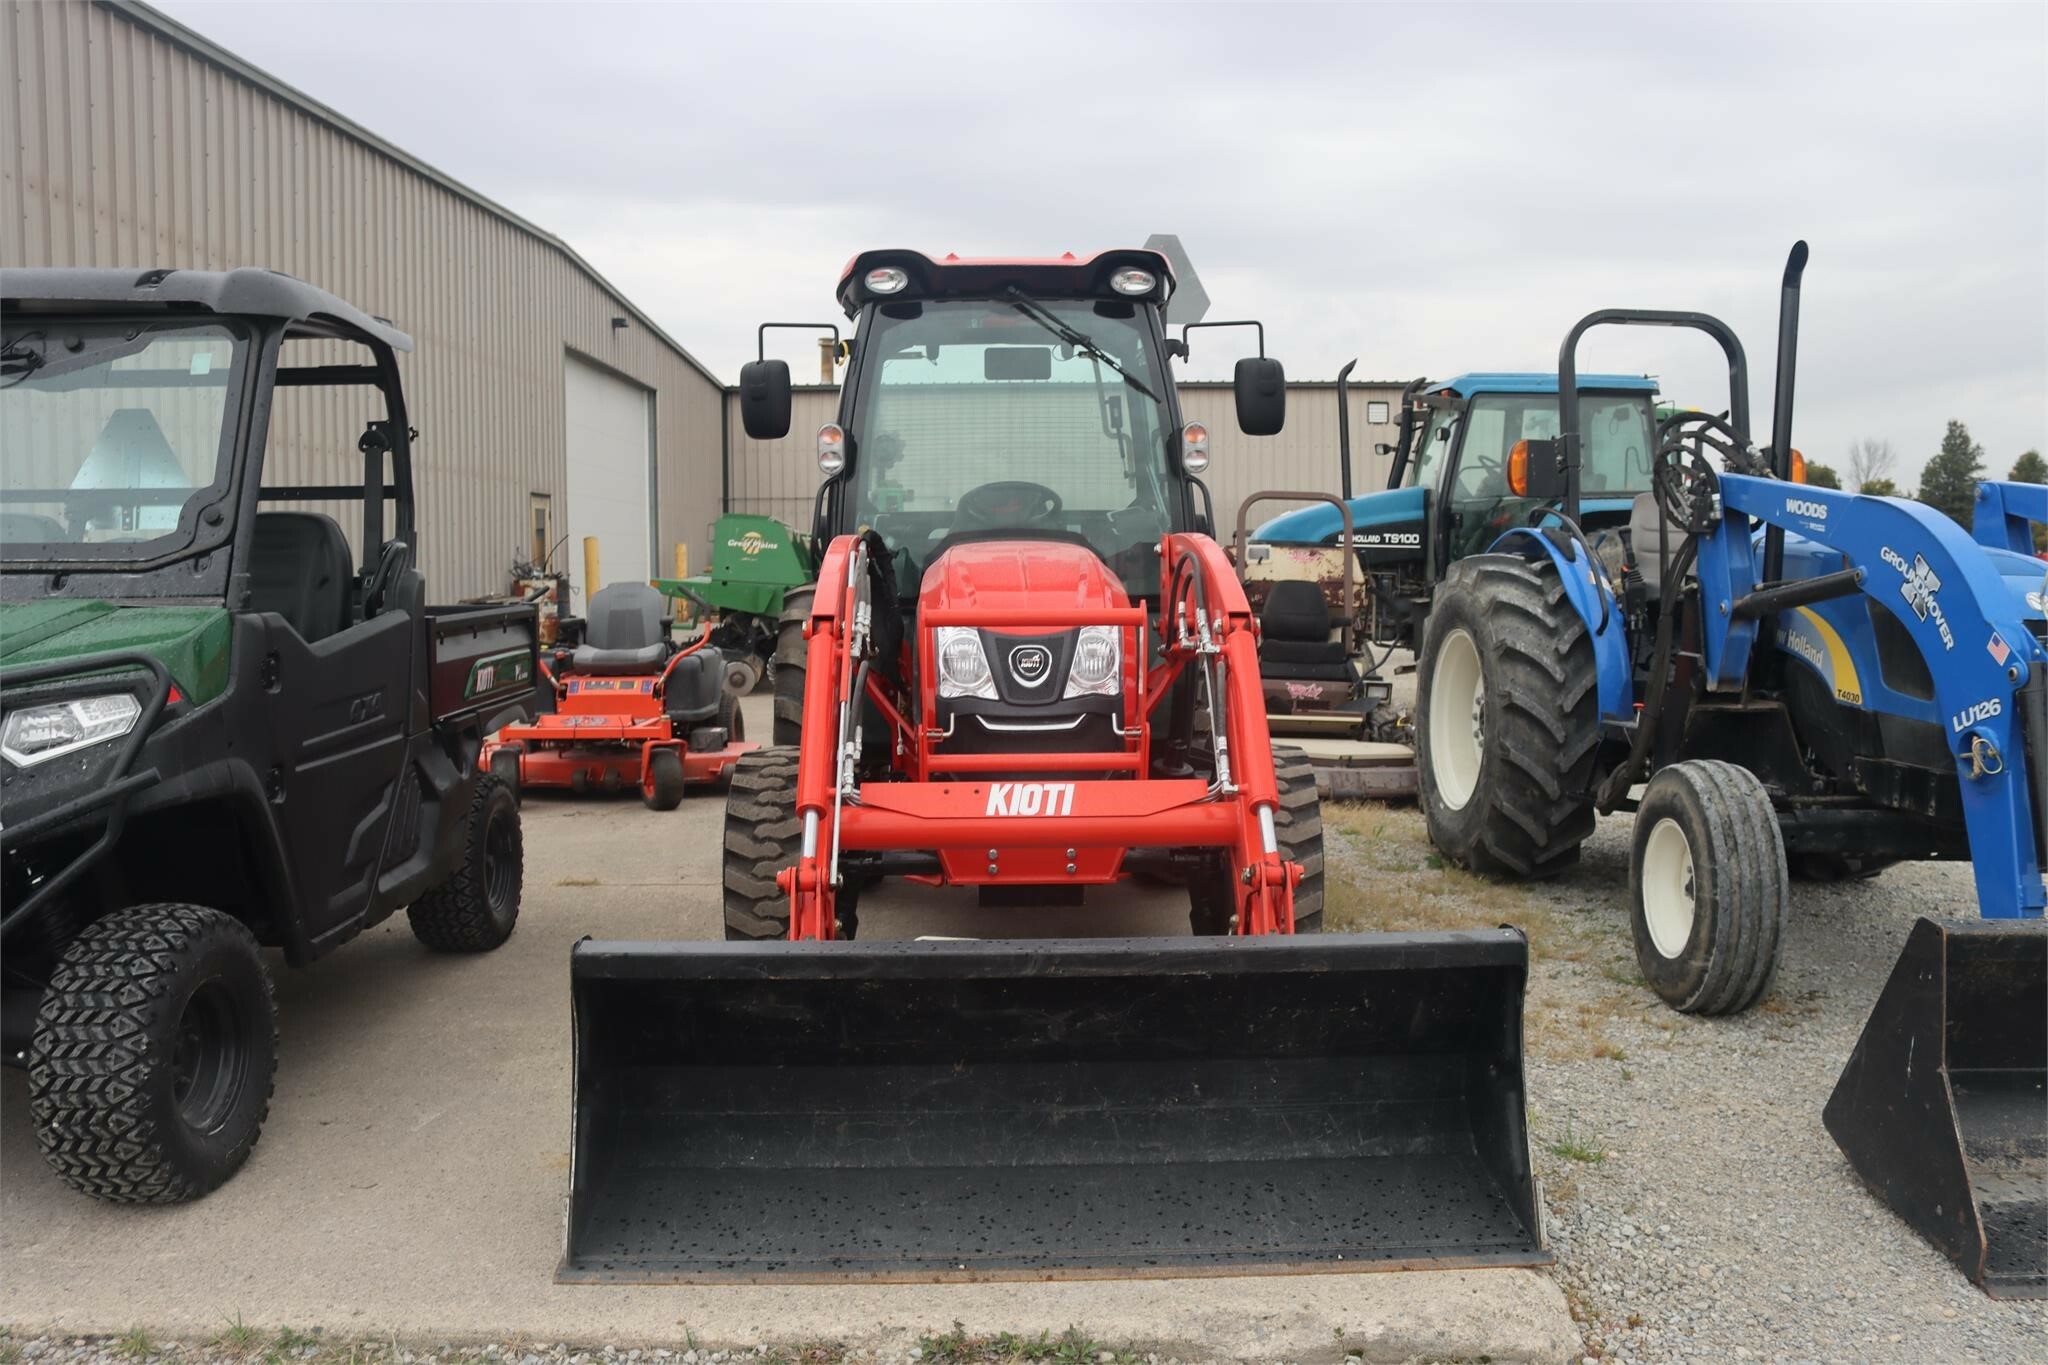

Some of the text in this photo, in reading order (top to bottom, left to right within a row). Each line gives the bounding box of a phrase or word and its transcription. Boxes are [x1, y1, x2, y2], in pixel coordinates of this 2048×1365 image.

[1786, 498, 1828, 520] WOODS
[727, 538, 754, 548] Great
[1352, 534, 1381, 544] HOLLAND
[1383, 533, 1420, 544] TS100
[1880, 546, 1955, 651] GROUNDMOVER
[1787, 629, 1824, 667] Holland
[1837, 688, 1860, 703] T4030
[1952, 697, 2002, 733] LU126
[985, 783, 1075, 817] KIOTI
